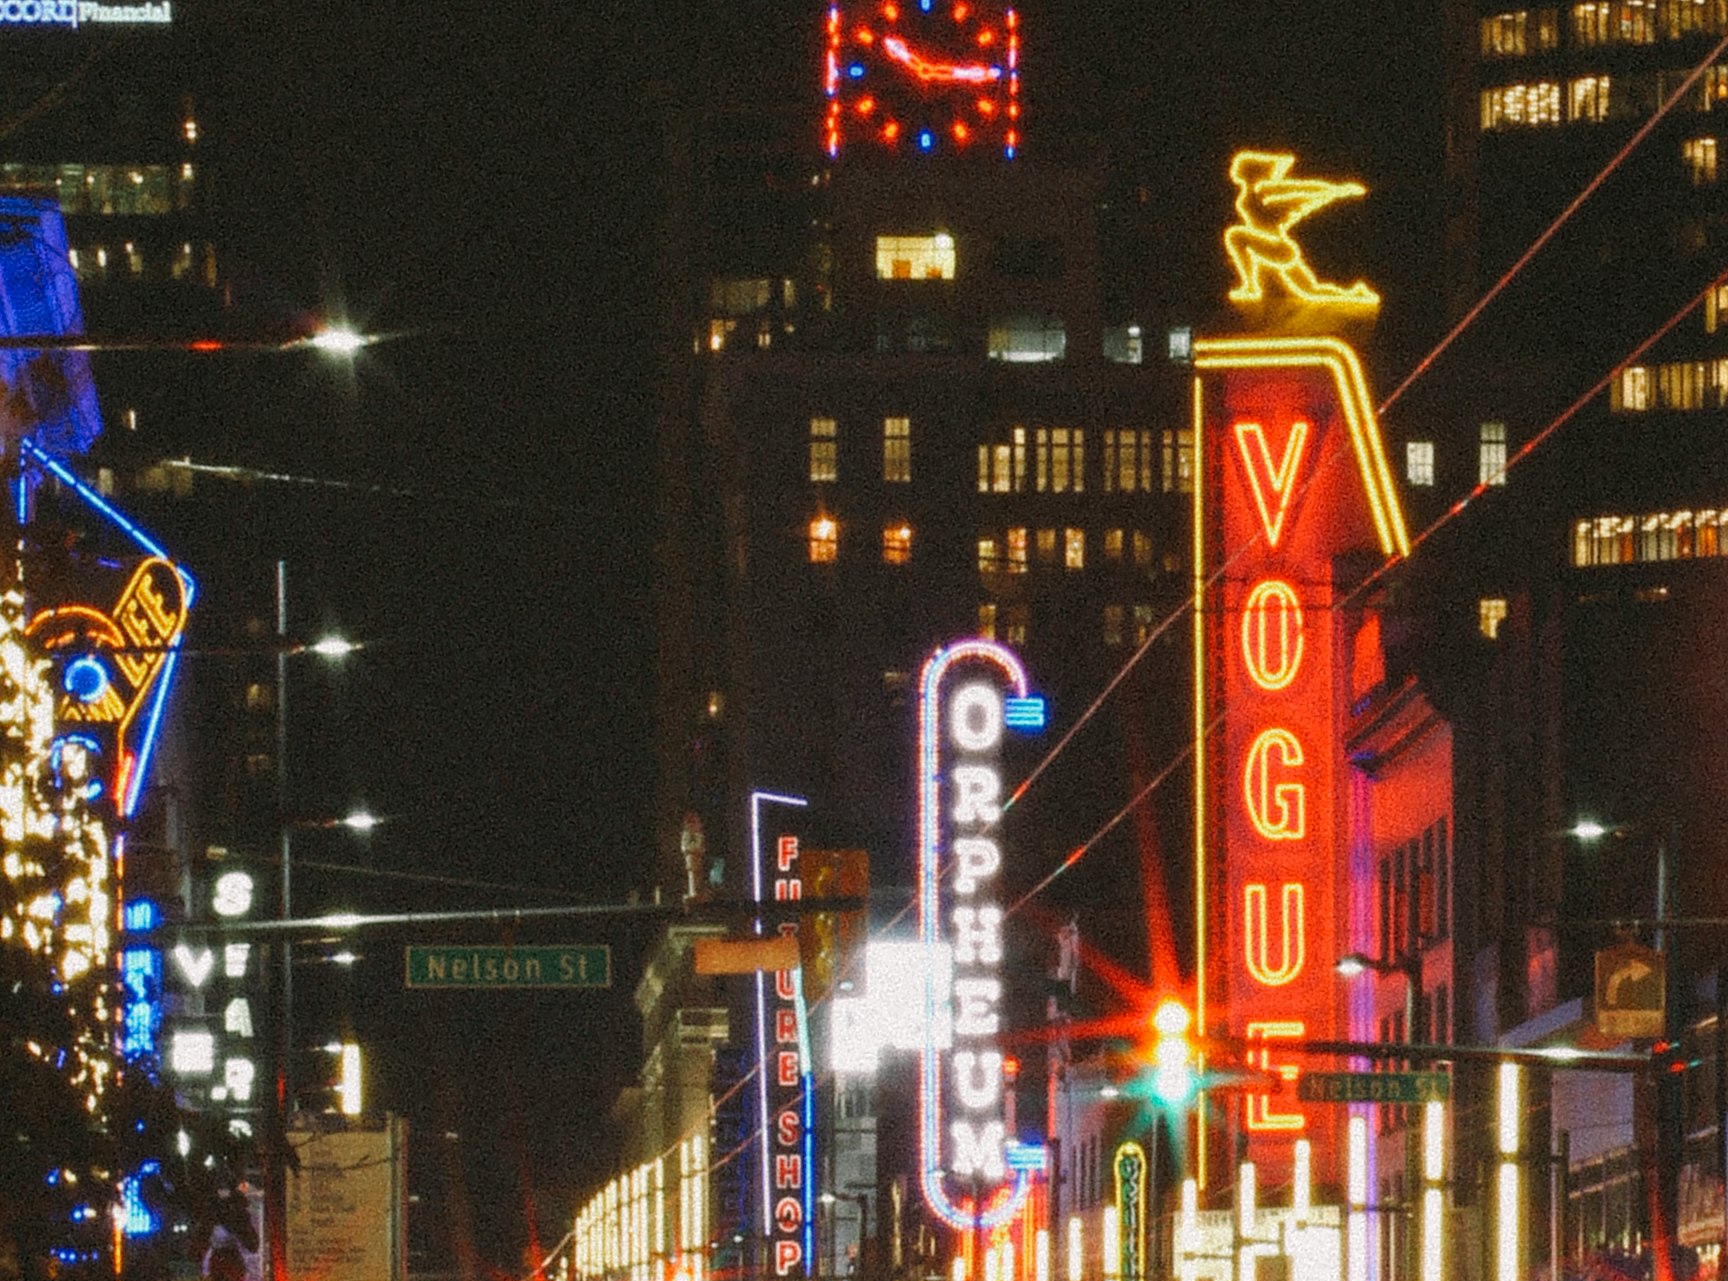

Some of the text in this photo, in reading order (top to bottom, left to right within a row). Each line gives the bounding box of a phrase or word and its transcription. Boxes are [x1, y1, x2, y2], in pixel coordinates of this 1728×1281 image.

[949, 682, 1002, 1180] ORPHEUM
[1234, 422, 1307, 1131] VOGUE
[428, 954, 587, 981] Nelson St
[774, 1110, 802, 1276] SHOP
